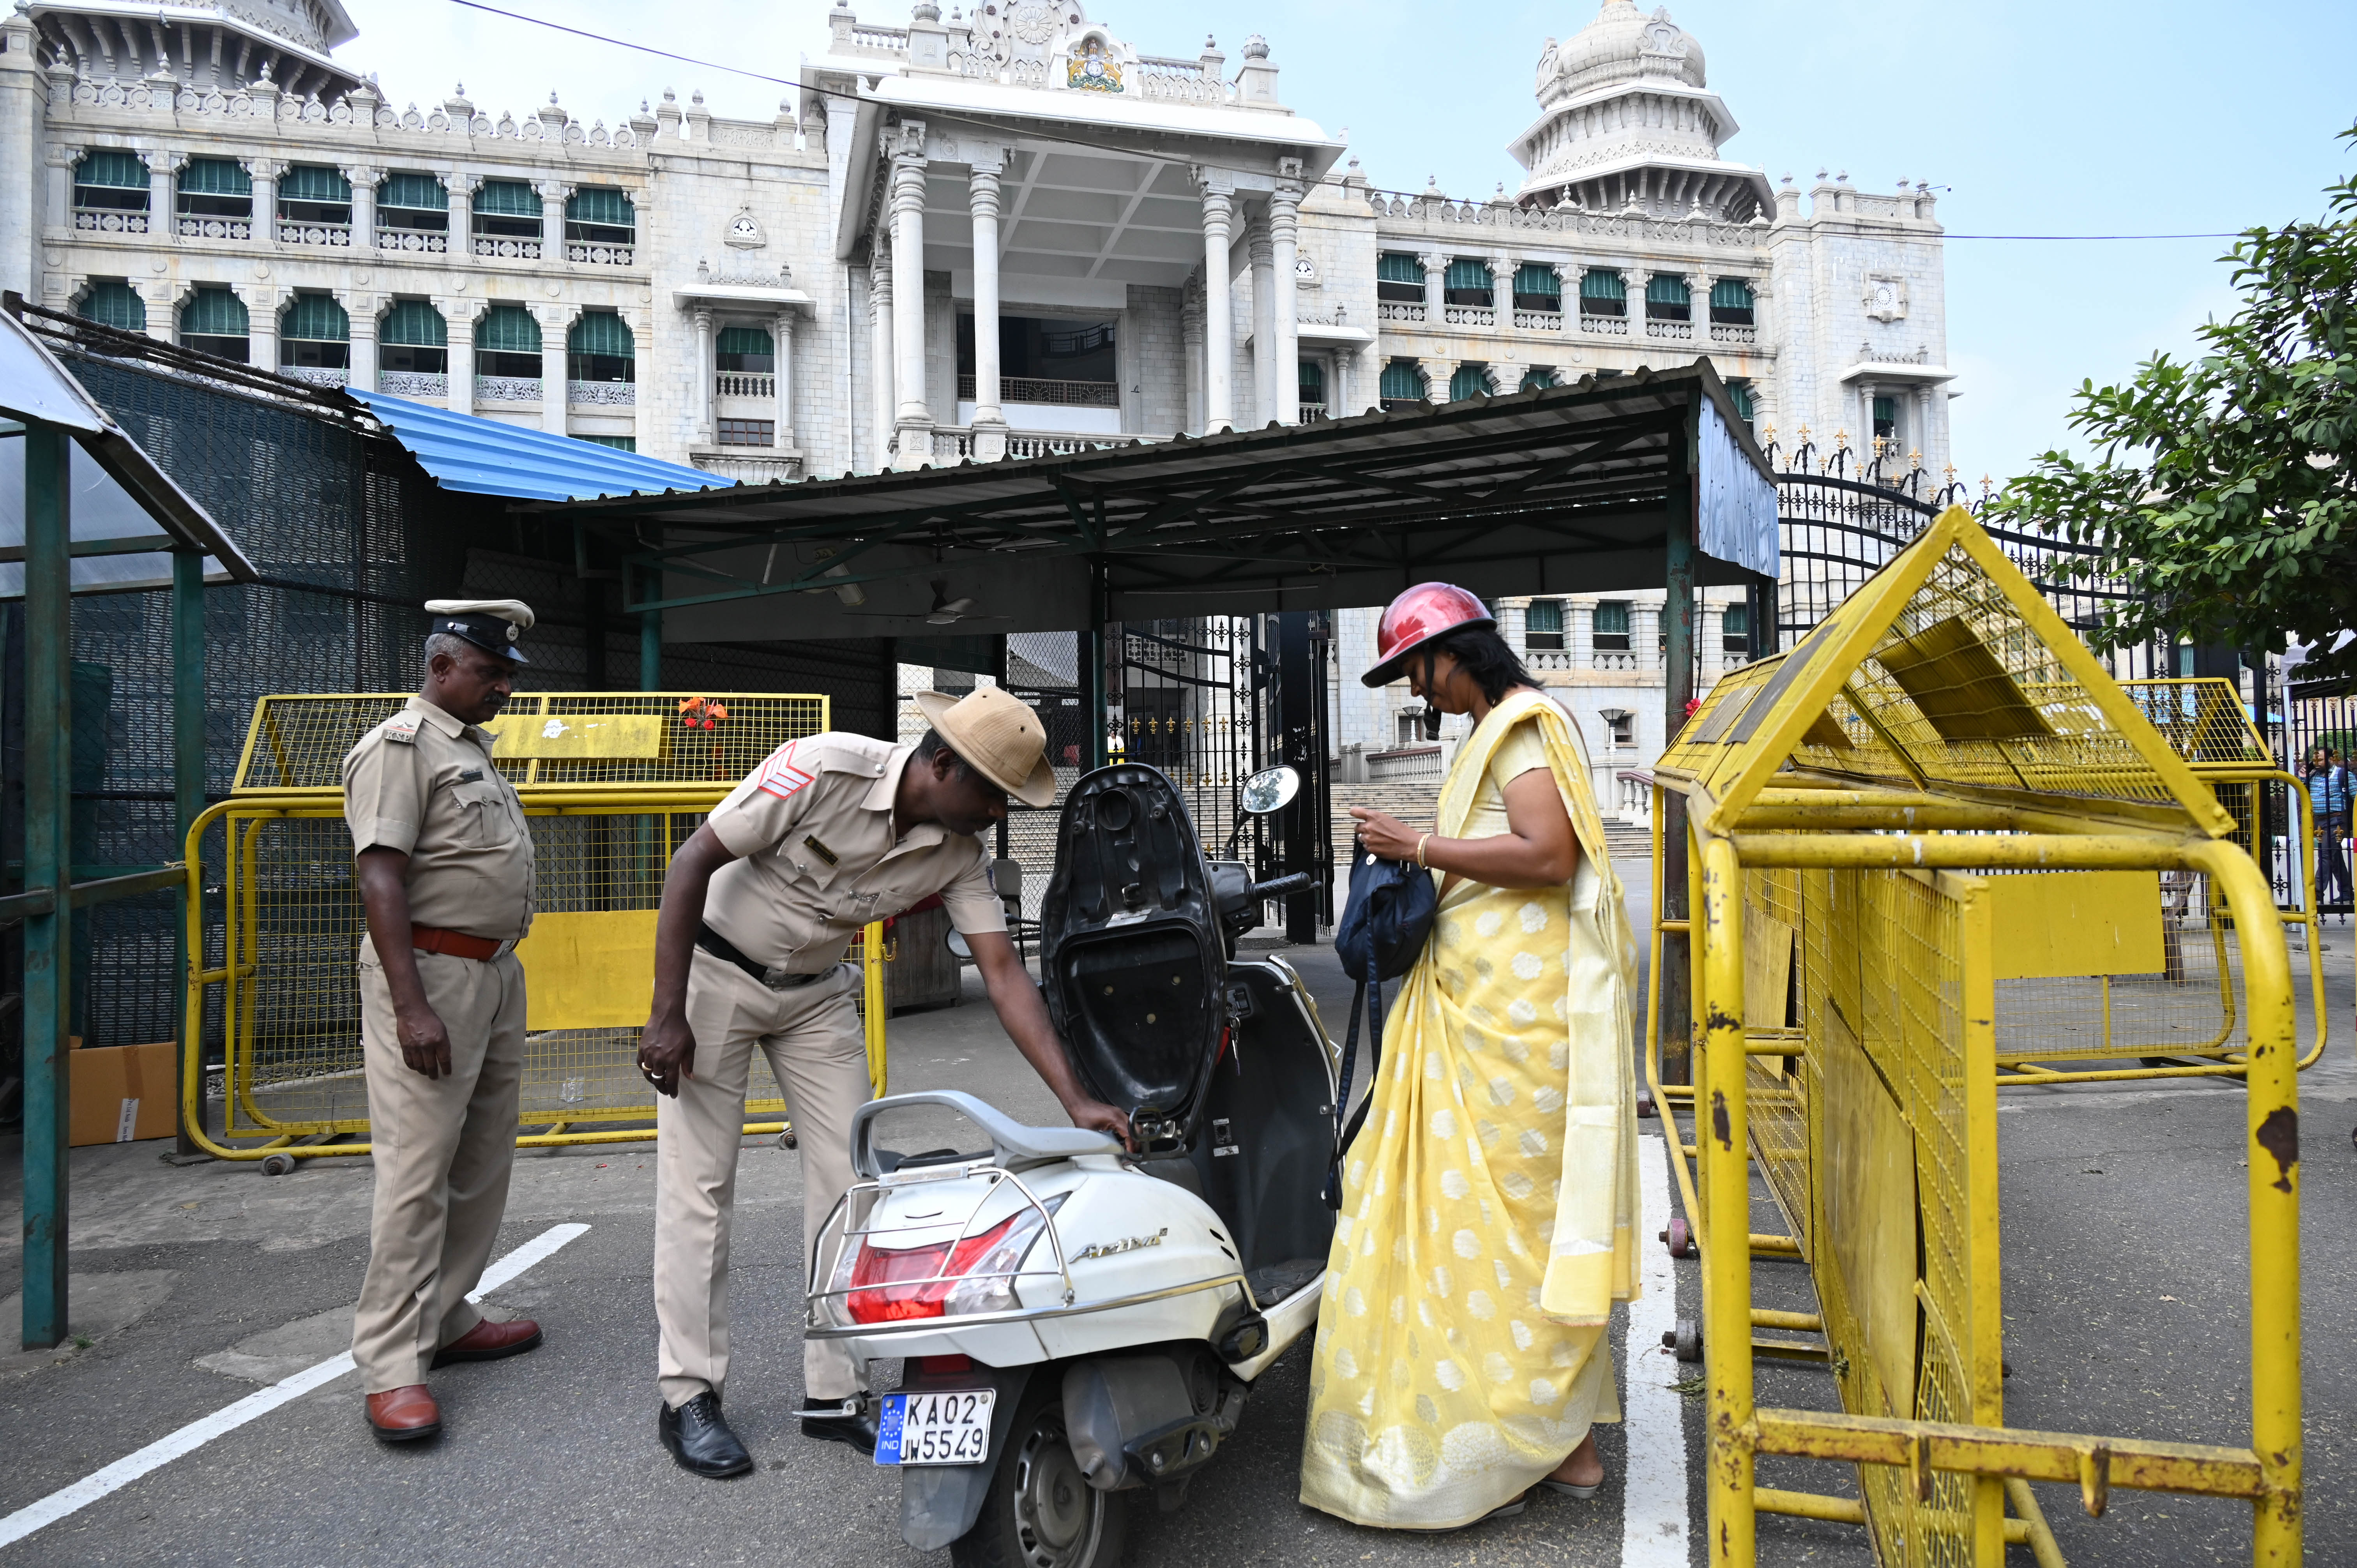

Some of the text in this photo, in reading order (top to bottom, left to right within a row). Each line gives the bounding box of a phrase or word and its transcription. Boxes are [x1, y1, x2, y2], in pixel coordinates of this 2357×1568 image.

[385, 730, 411, 742] KSP
[908, 1395, 976, 1425] KA02
[881, 1440, 899, 1450] IND
